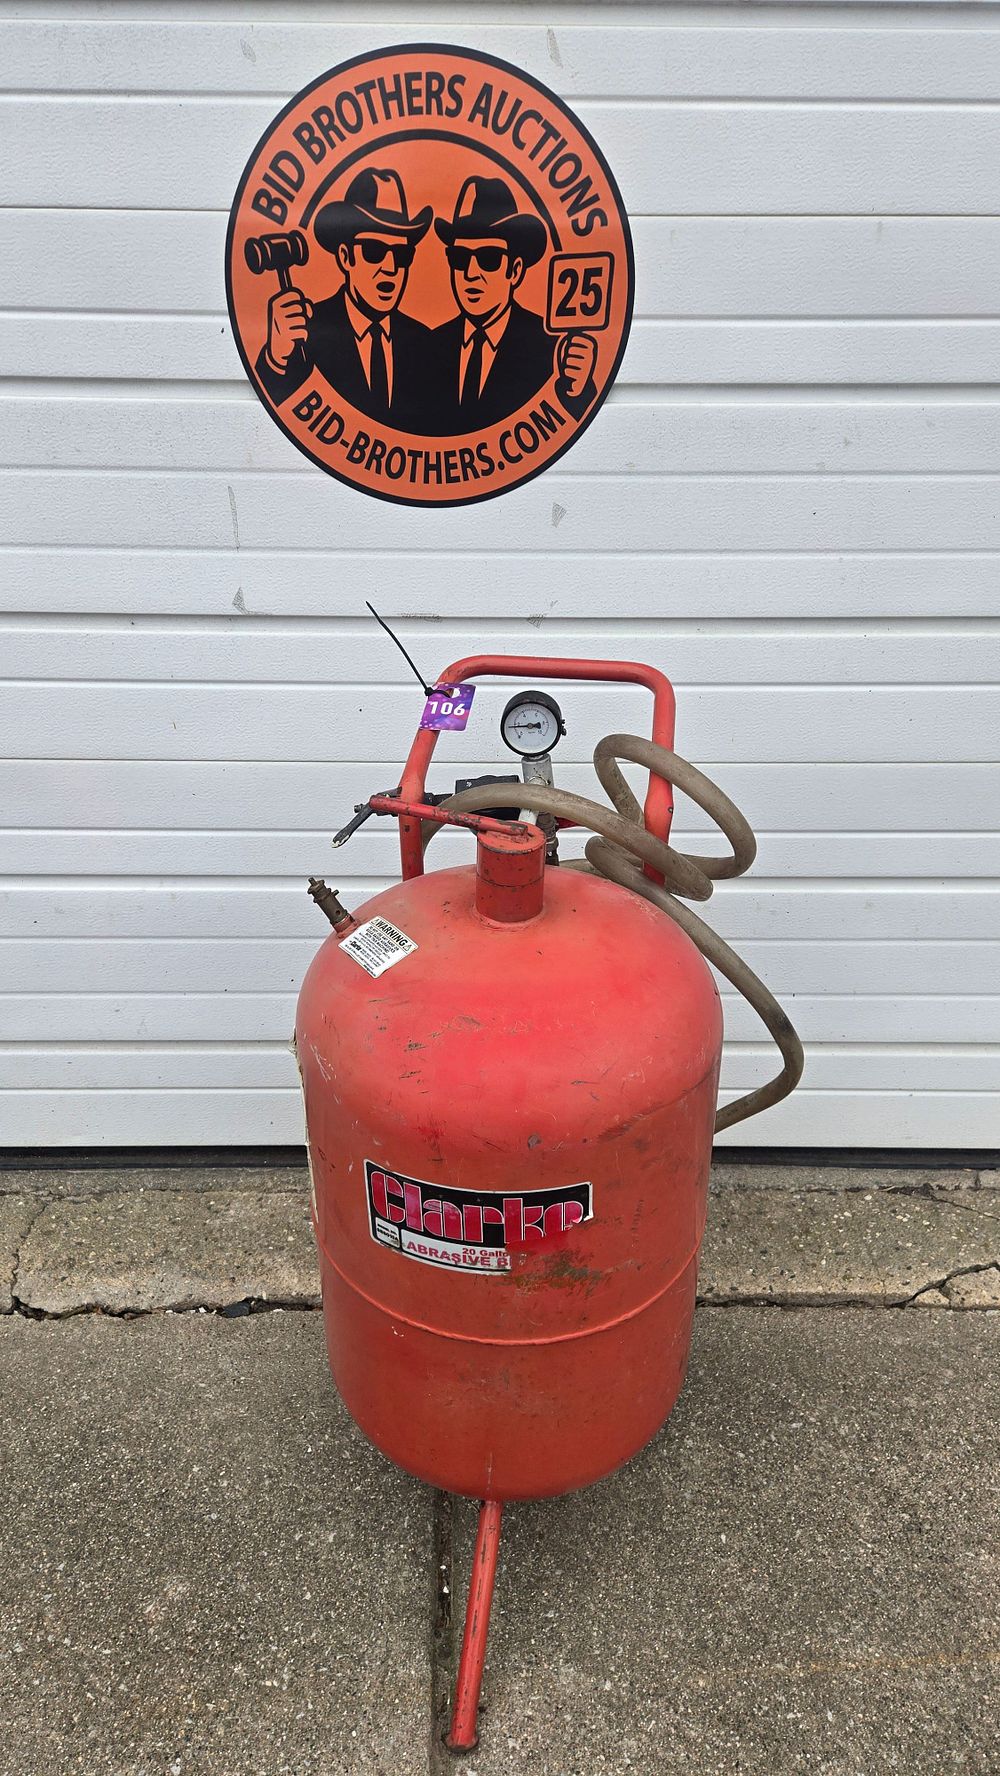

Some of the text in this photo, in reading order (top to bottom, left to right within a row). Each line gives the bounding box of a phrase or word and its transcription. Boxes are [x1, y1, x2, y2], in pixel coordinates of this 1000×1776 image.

[251, 71, 609, 237] BID BROTHERS AUCTIONS
[554, 266, 604, 318] 25
[291, 389, 567, 486] BID-BROTHERS.COM
[429, 701, 466, 716] 106
[376, 920, 408, 946] WARNING
[370, 1171, 584, 1244] Clarke
[406, 1240, 491, 1267] ABRASIVE
[462, 1248, 476, 1256] 20
